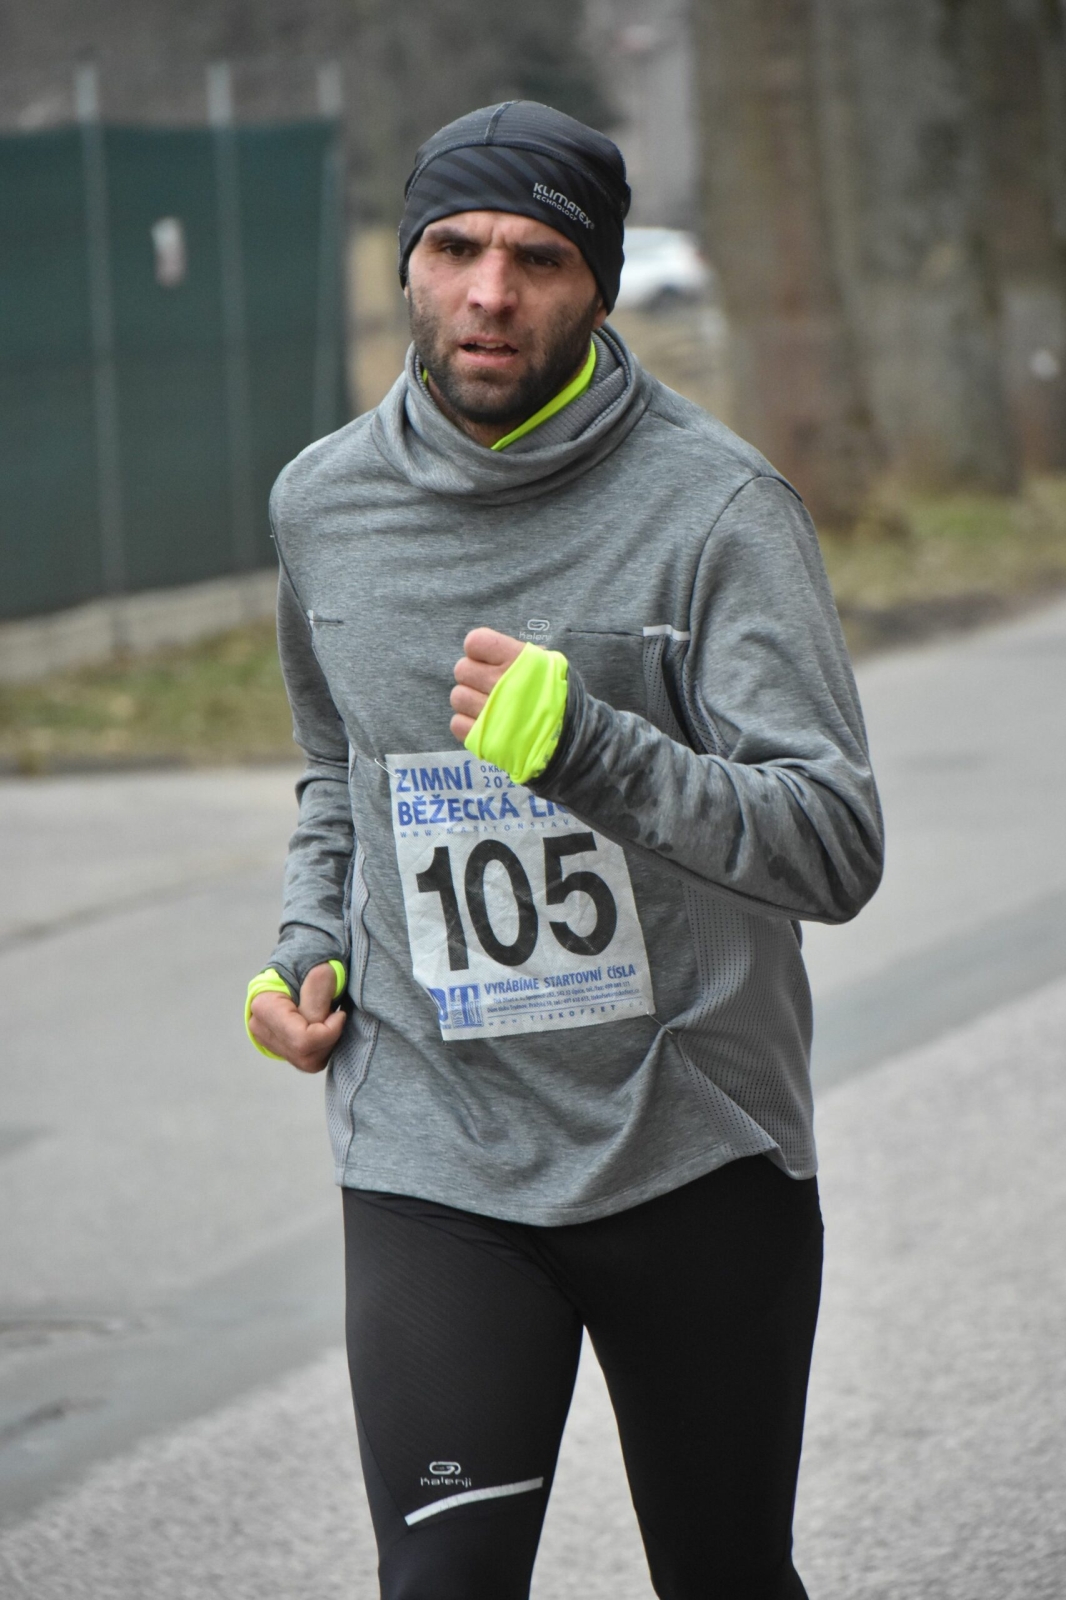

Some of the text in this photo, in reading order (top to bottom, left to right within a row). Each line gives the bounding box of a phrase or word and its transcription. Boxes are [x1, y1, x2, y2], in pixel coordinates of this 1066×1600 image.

[532, 192, 578, 221] TECHNOLOGY
[533, 182, 591, 229] KLIMATEX
[519, 631, 552, 641] Kalen
[394, 760, 473, 792] ZIMNÍ
[483, 775, 516, 788] 202
[397, 792, 520, 826] BĚŽECKÁ
[416, 831, 617, 972] 105
[484, 978, 540, 995] VYRÁBÍME
[544, 967, 602, 988] STARTOVNÍ
[607, 963, 636, 979] ČÍSLA
